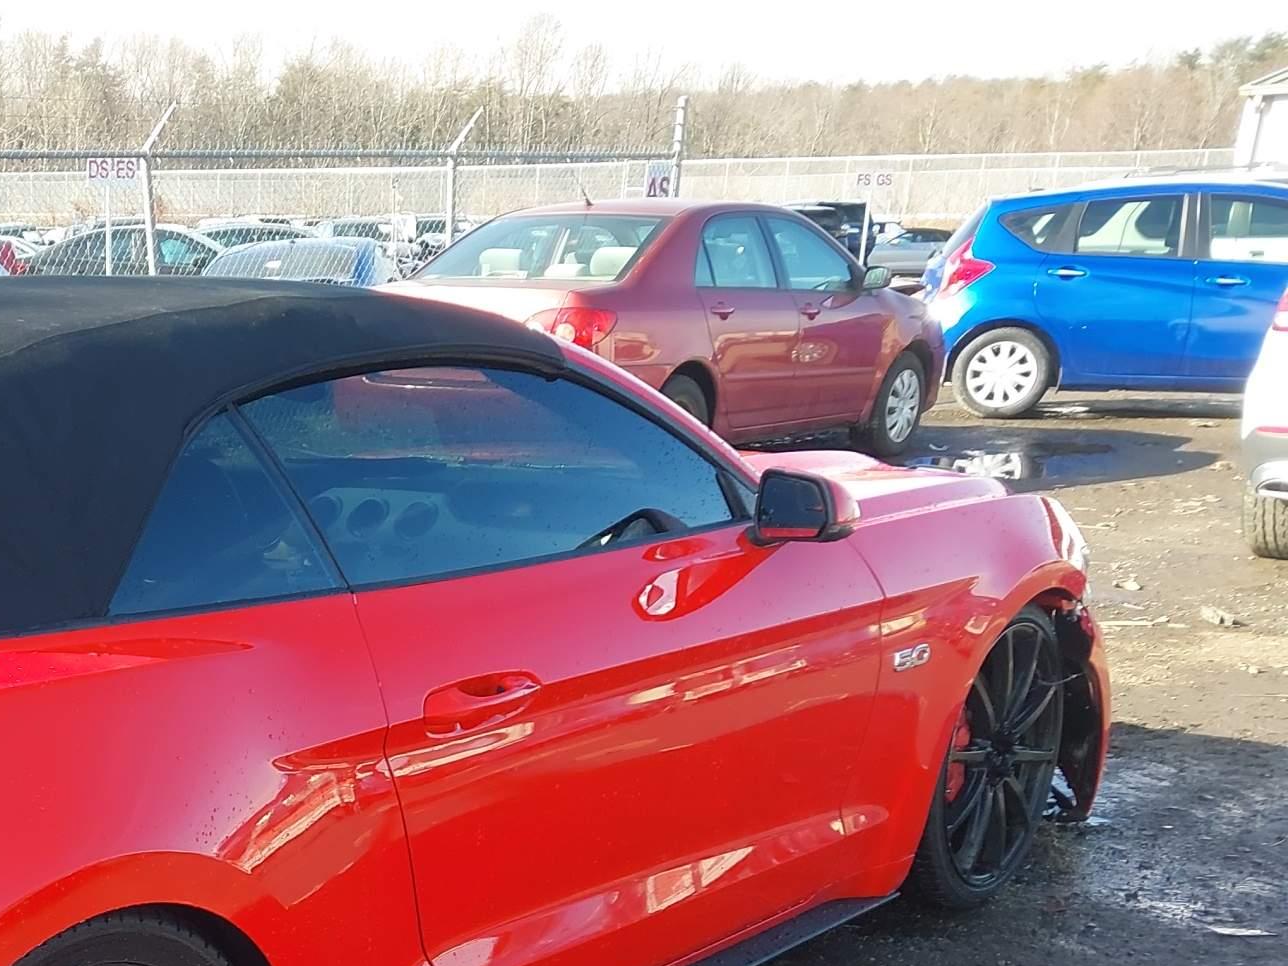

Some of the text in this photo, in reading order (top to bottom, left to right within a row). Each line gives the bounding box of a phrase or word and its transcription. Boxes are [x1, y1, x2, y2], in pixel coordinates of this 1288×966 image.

[88, 160, 136, 179] DS ES
[856, 173, 893, 186] FS GS
